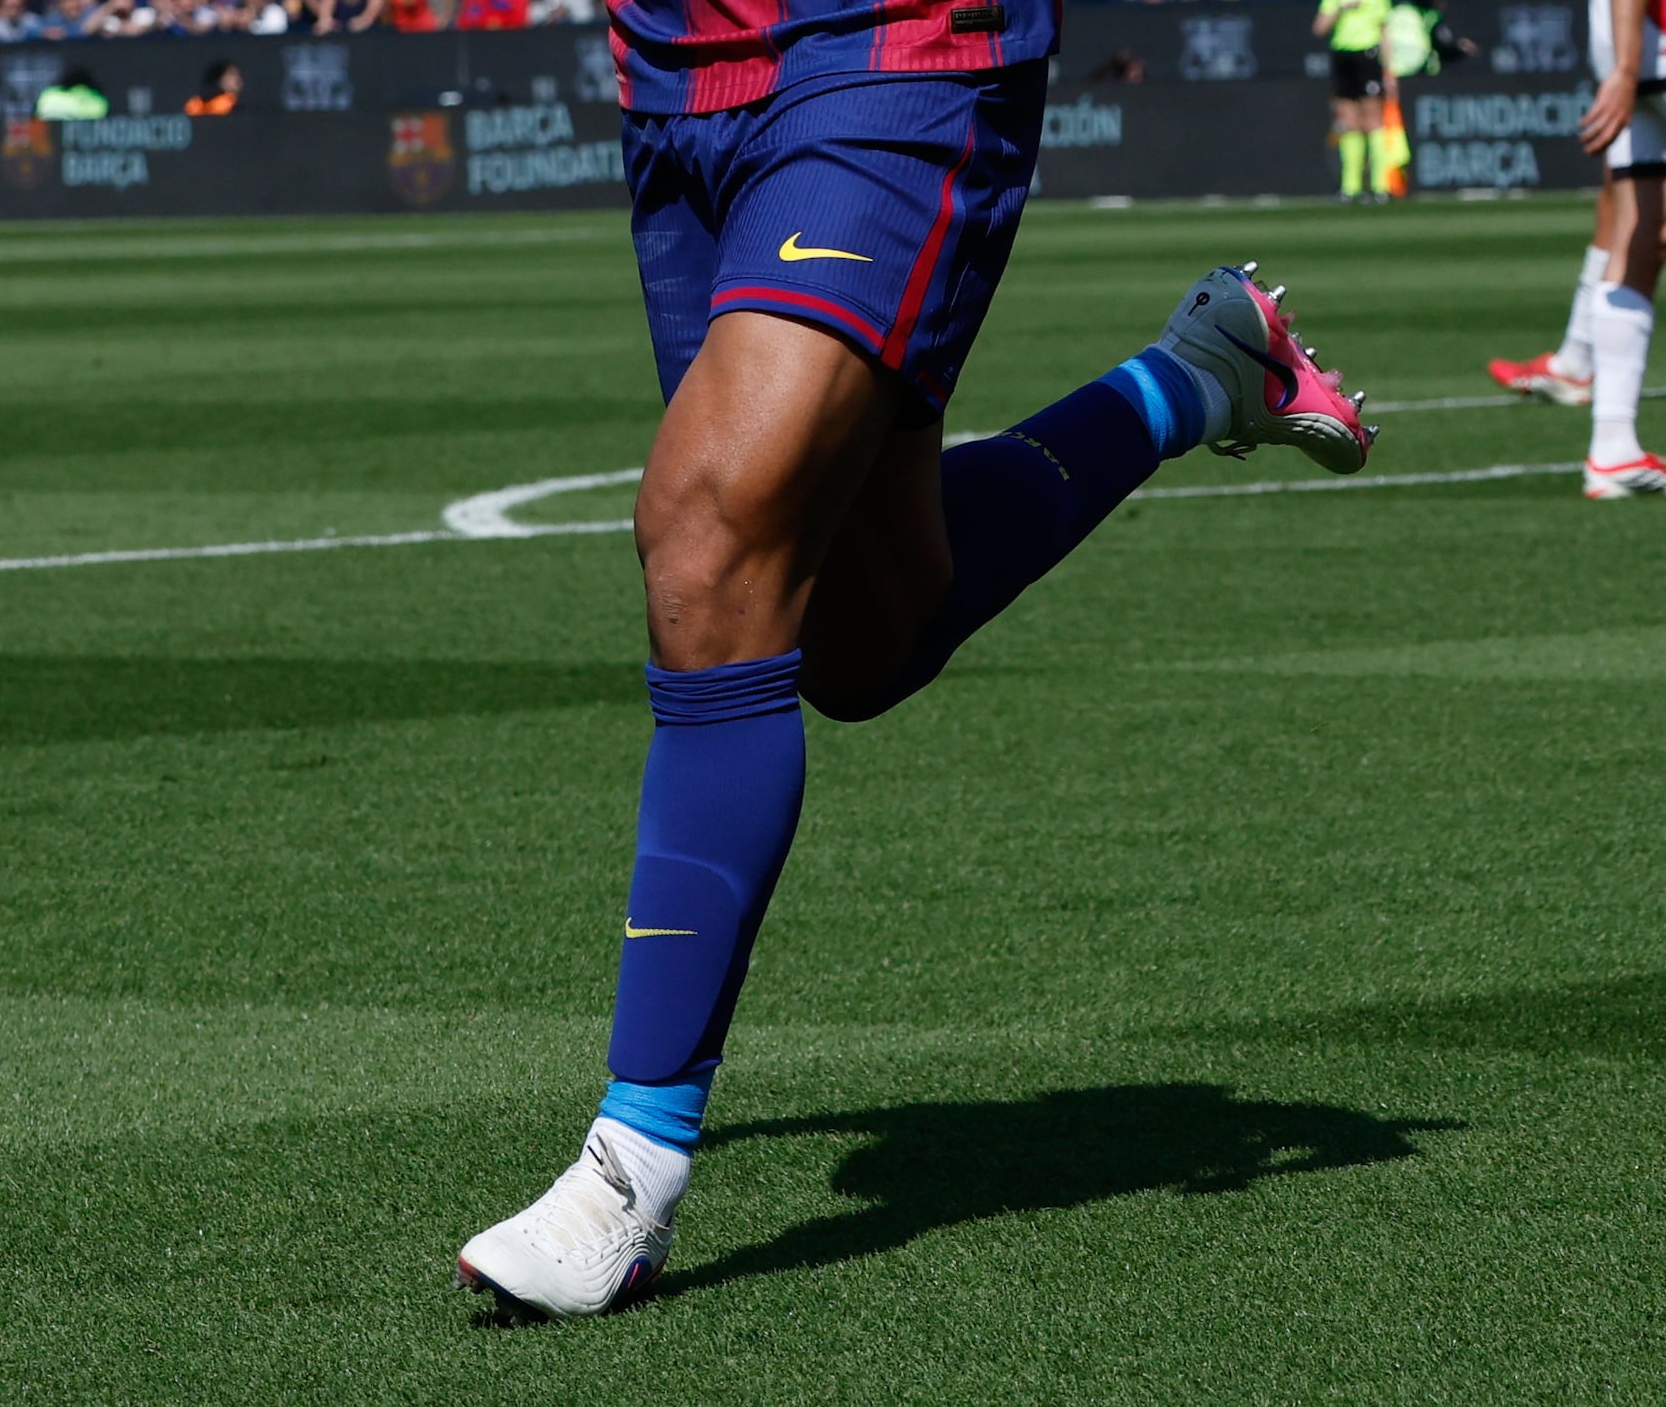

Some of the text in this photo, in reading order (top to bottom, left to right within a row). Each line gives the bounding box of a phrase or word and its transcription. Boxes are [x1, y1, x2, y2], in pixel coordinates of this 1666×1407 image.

[465, 103, 574, 152] BARÇA
[466, 138, 624, 195] FOUNDATI
[1416, 141, 1540, 191] BARÇA
